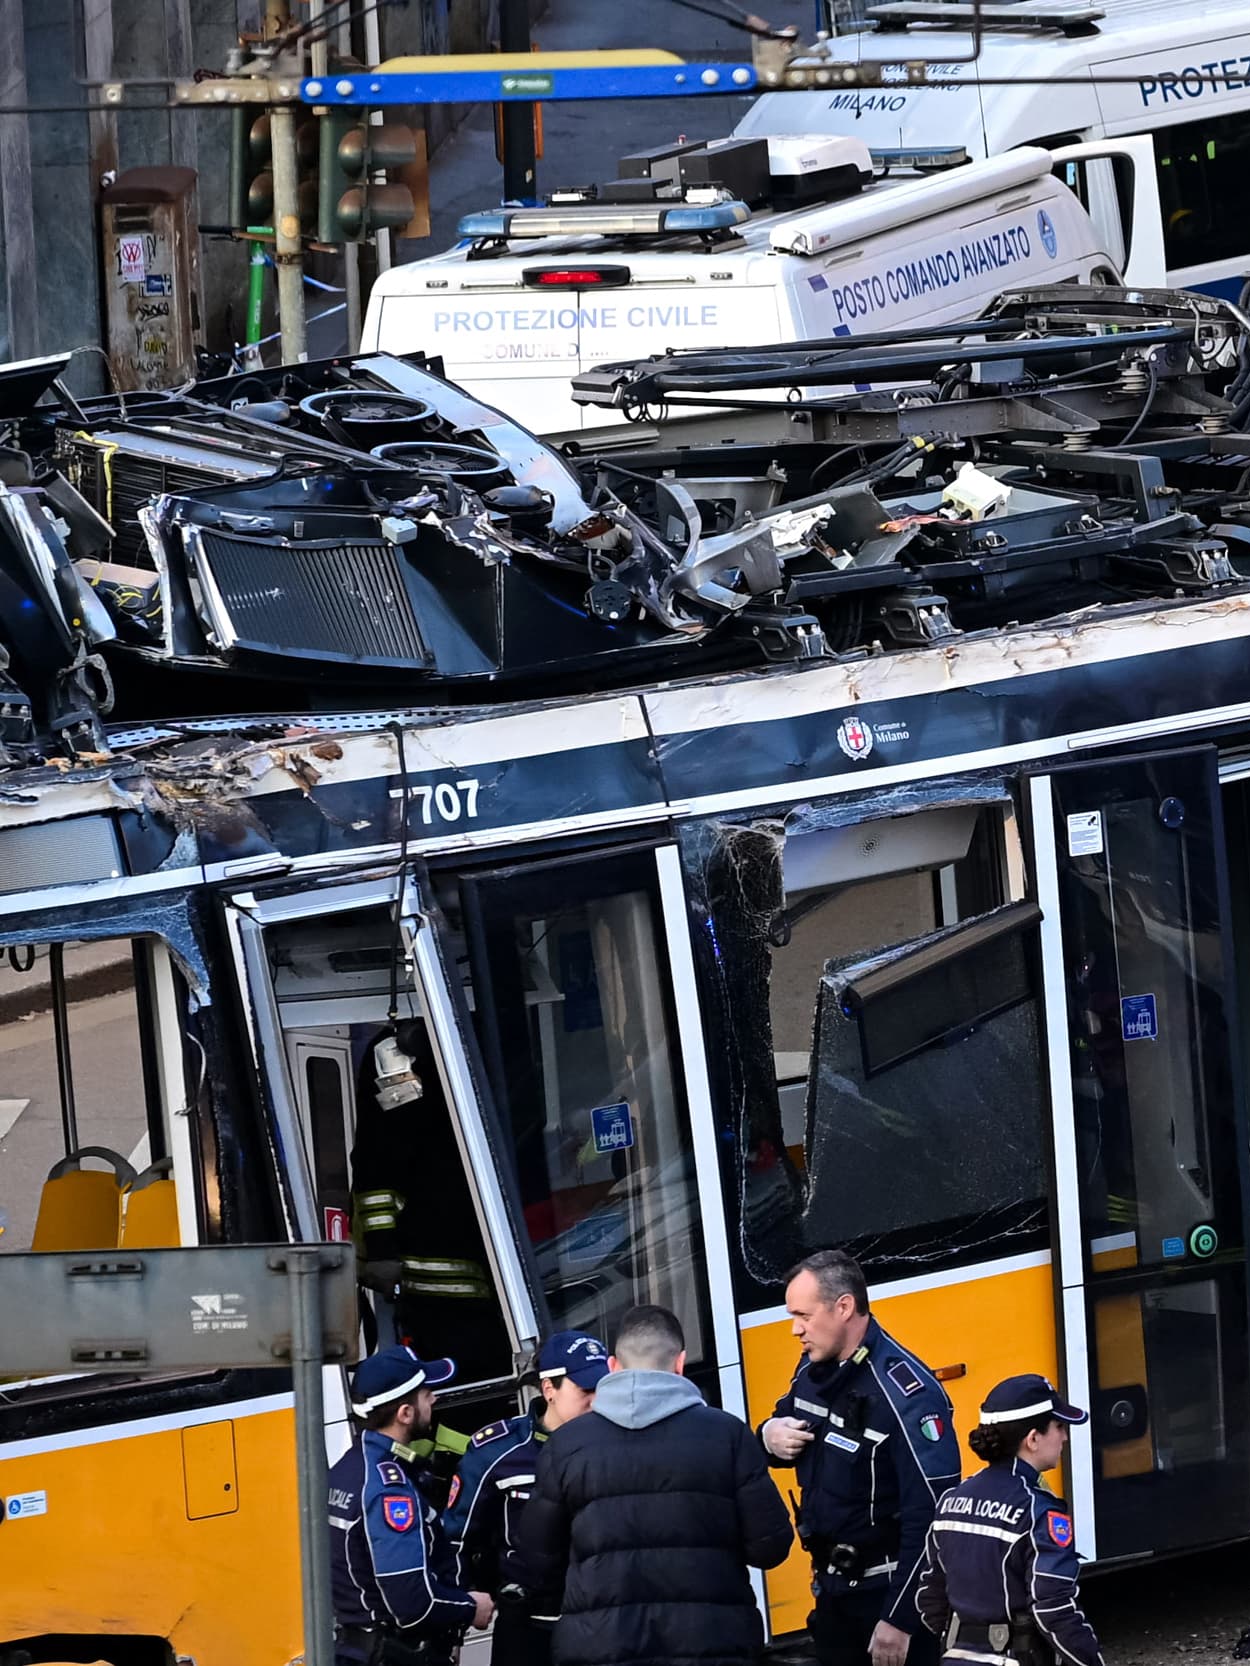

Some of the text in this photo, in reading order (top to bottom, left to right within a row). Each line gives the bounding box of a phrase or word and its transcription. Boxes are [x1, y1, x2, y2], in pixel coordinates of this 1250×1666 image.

[829, 95, 907, 112] MILANO
[832, 225, 1031, 322] POSTO COMANDO AVANZATO
[434, 305, 718, 332] PROTEZIONE CIVILE
[875, 730, 910, 743] Milano
[389, 779, 479, 826] 7707
[975, 1499, 1024, 1525] LOCALE
